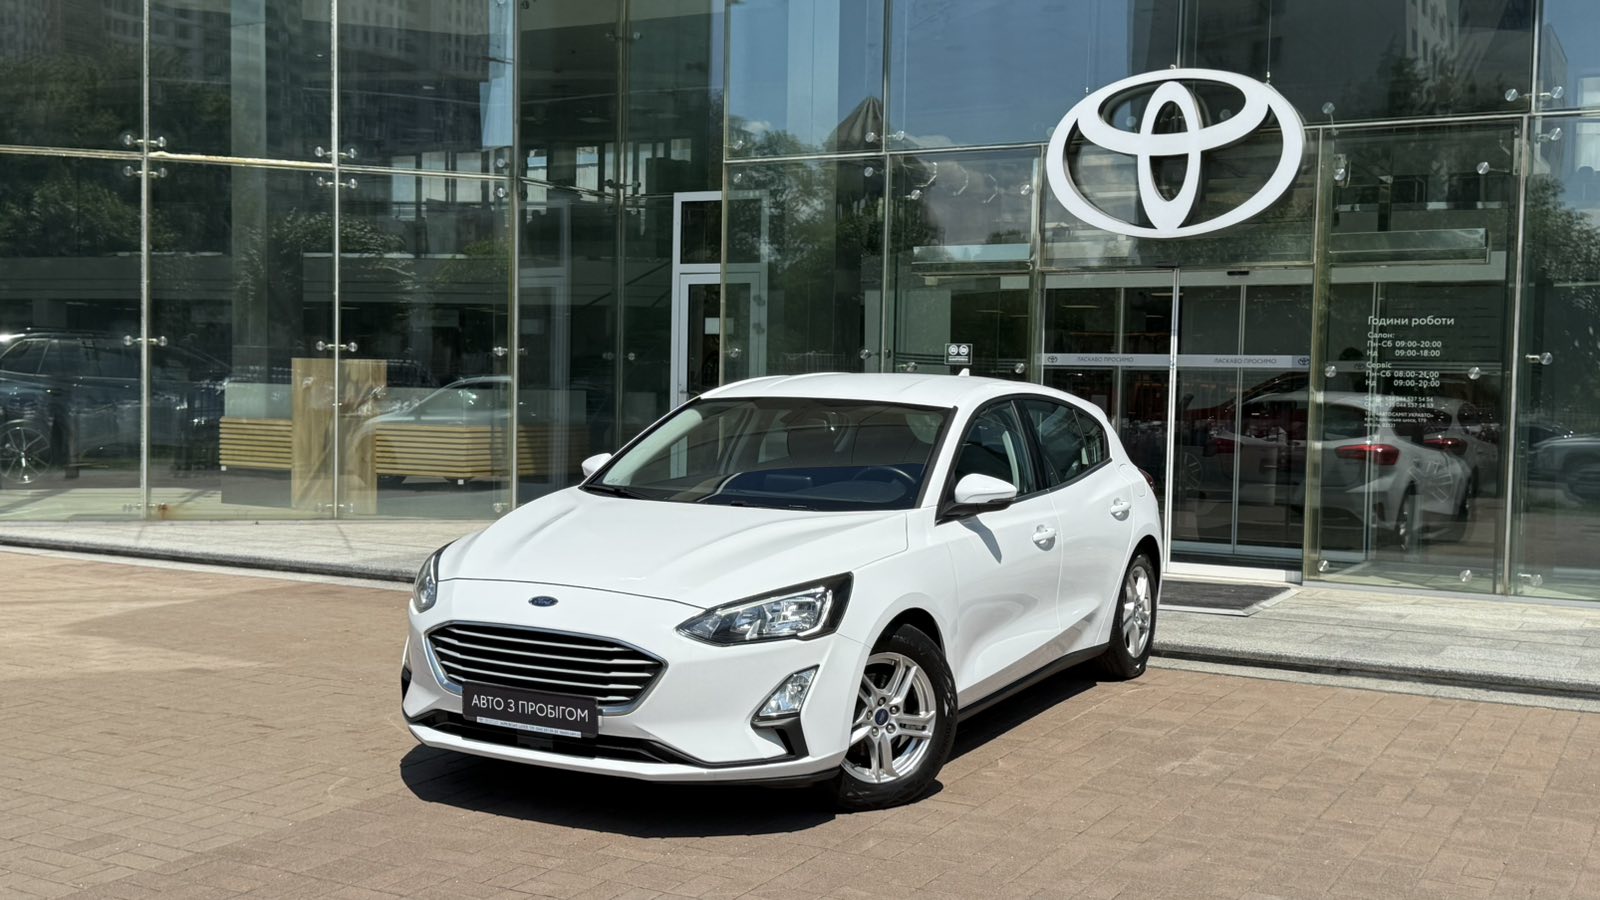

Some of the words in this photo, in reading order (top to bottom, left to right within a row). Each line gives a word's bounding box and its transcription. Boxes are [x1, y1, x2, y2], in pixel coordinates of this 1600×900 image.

[1368, 315, 1409, 326] Години
[1411, 315, 1455, 327] роботи
[472, 694, 504, 710] АВТО
[507, 700, 515, 712] З
[518, 700, 589, 722] ПРОБІГОМ
